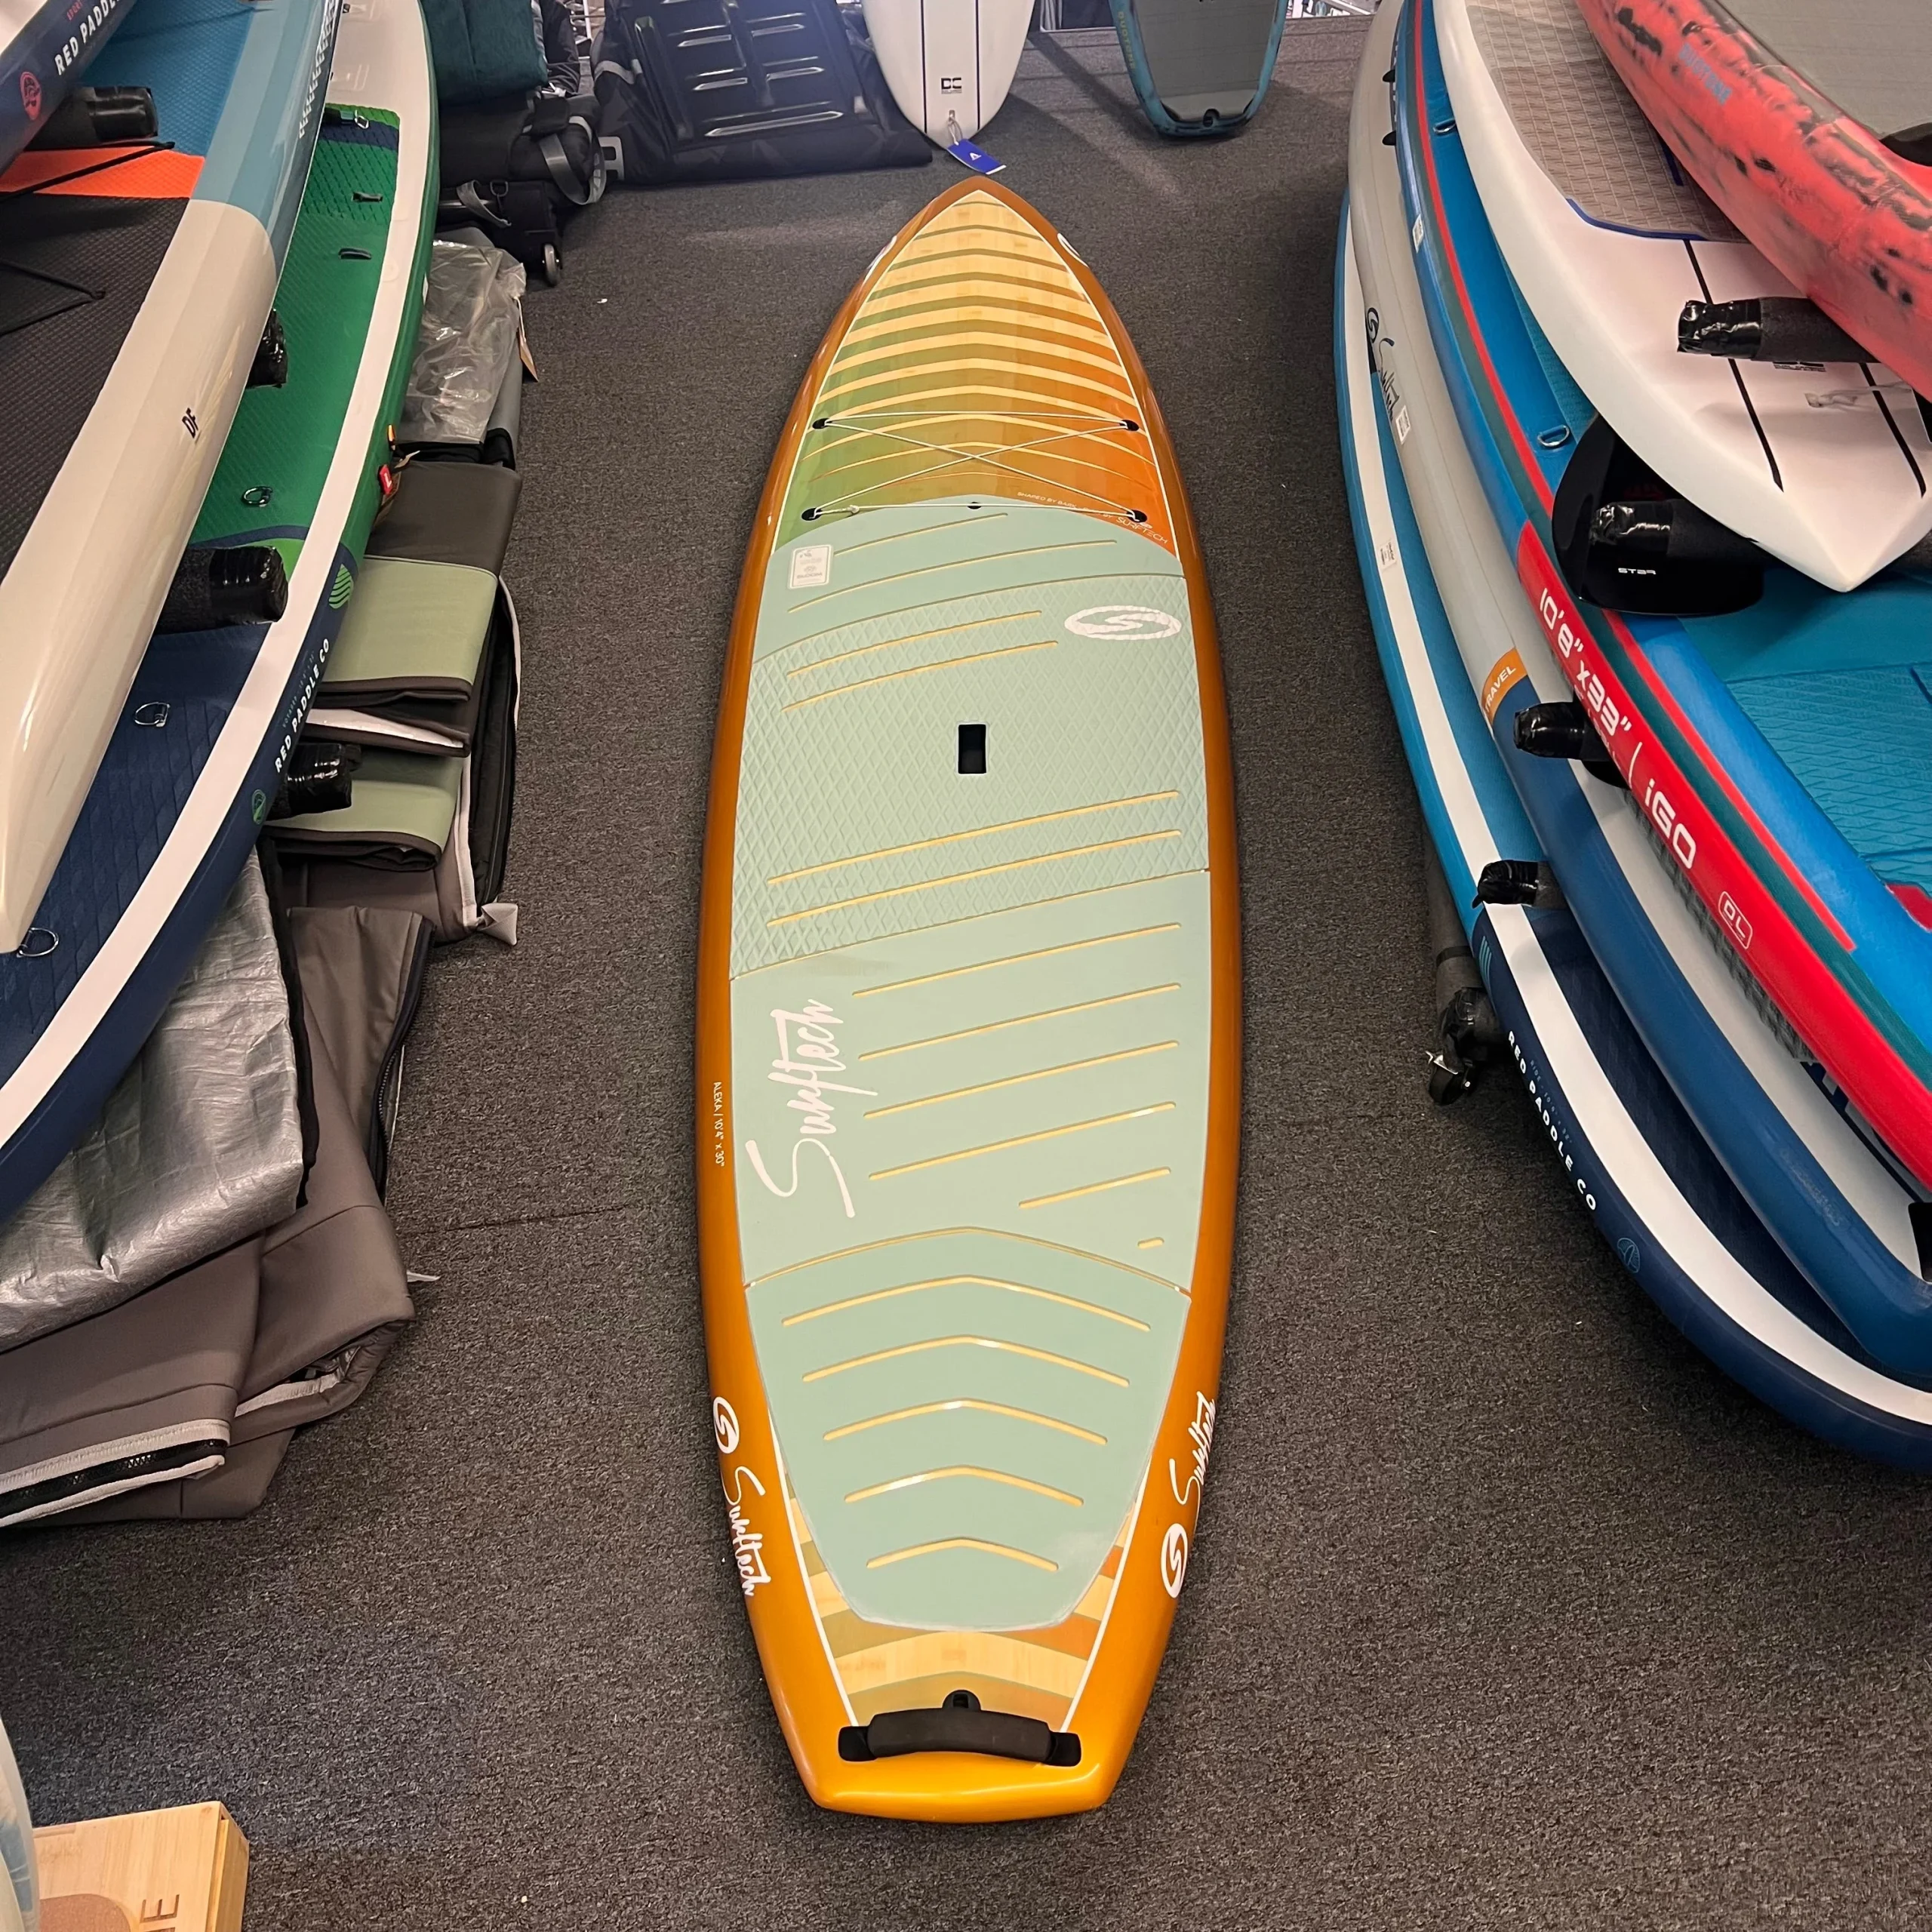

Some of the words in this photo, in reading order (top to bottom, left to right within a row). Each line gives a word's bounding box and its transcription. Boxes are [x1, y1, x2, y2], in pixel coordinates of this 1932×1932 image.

[54, 36, 78, 75] RED
[79, 0, 120, 44] PADD
[181, 408, 198, 438] DF
[1017, 491, 1046, 501] SHAPED
[1057, 500, 1077, 509] BARK
[1115, 516, 1168, 544] SURFTECH
[275, 734, 291, 774] RED
[291, 663, 320, 733] PADDLE
[319, 638, 330, 663] CO
[1484, 666, 1517, 713] TRAVEL
[713, 1081, 722, 1112] ALEKA
[744, 998, 878, 1219] Surftech
[1509, 1030, 1527, 1075] RED
[1528, 1079, 1574, 1172] PADDLE
[1577, 1178, 1597, 1211] CO
[719, 1466, 771, 1597] Surftech
